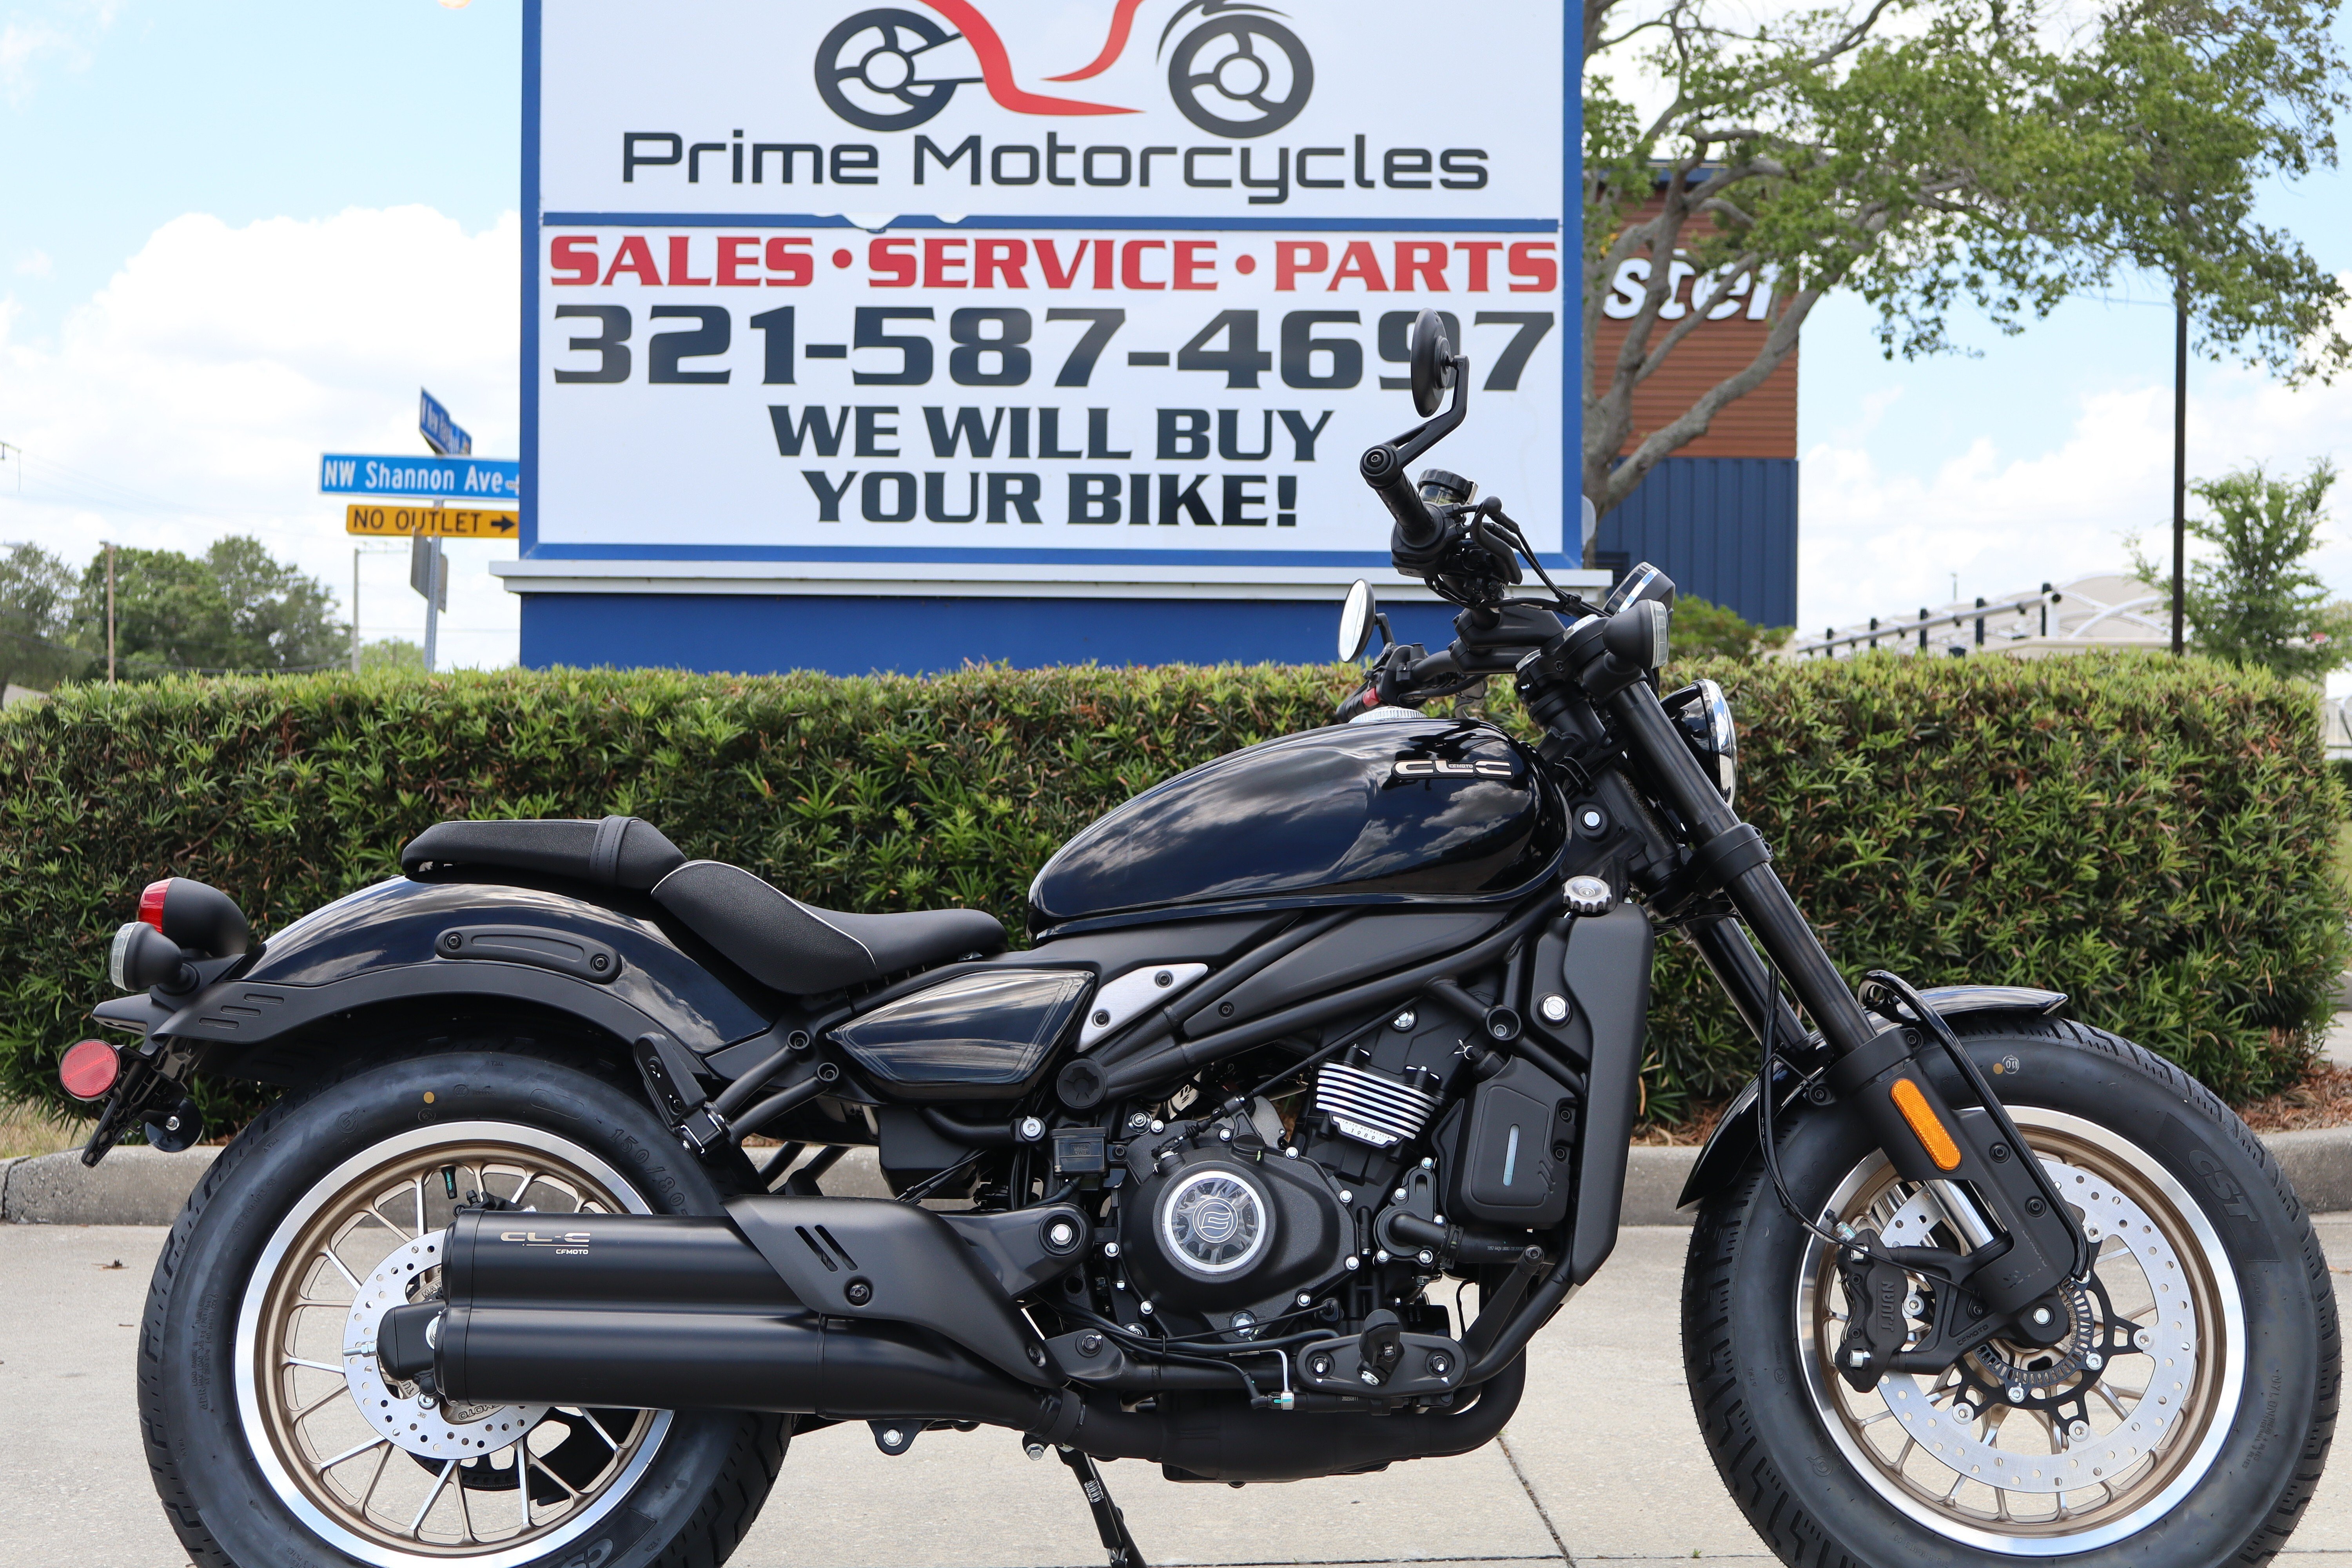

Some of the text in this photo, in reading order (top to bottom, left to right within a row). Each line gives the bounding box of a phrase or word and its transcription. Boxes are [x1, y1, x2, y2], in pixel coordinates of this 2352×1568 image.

[624, 131, 1488, 204] Prime Motorcycles
[551, 236, 1557, 292] SALES SERVICE PARTS
[555, 305, 1554, 390] 321-587-4697
[768, 406, 1333, 461] WE WILL BUY
[324, 460, 503, 493] NW Shannon Ave
[802, 471, 1296, 526] YOUR BIKE!
[354, 509, 482, 533] NO OUTLET
[1340, 1120, 1390, 1139] CFMOTO MOTORCYCLE
[1351, 1128, 1376, 1140] 1989
[2188, 1150, 2259, 1223] CST
[1956, 1324, 1989, 1347] CFMOTO
